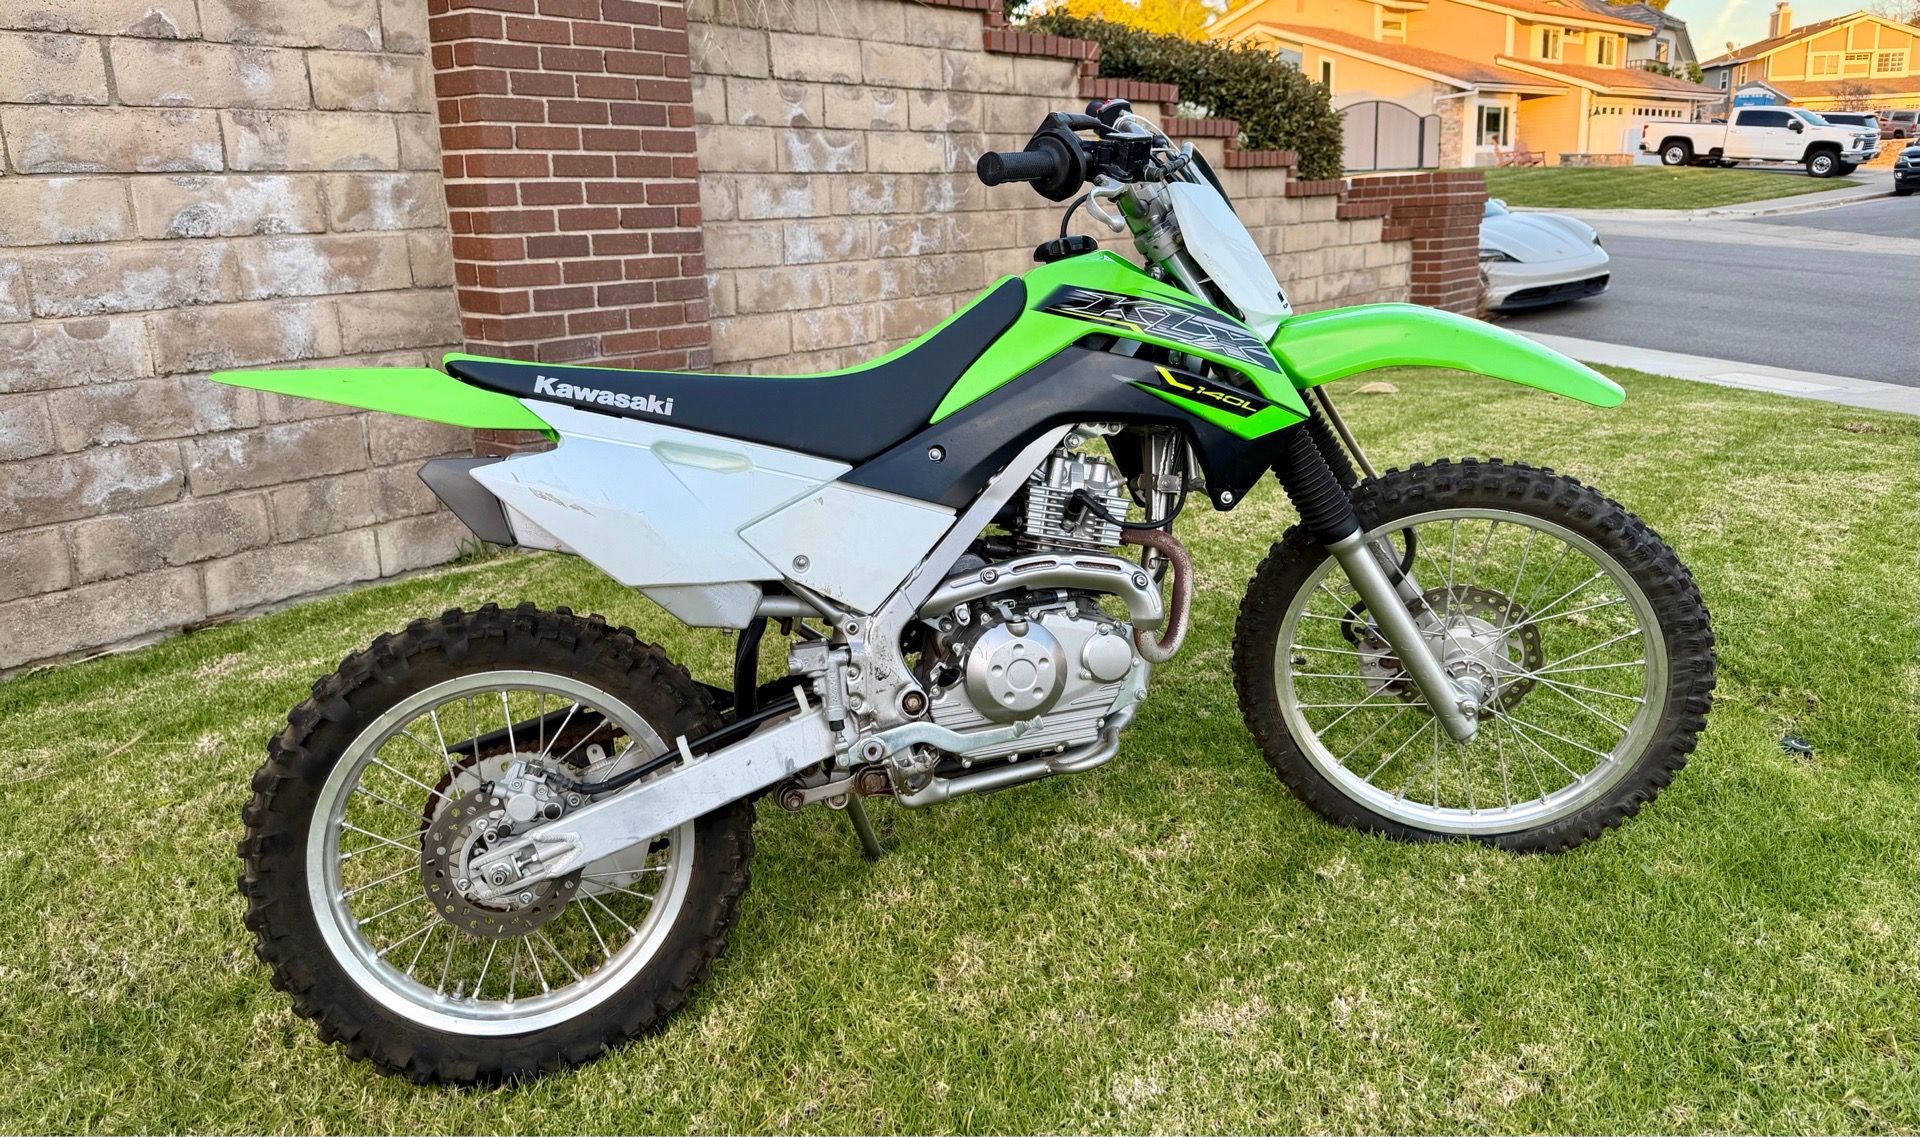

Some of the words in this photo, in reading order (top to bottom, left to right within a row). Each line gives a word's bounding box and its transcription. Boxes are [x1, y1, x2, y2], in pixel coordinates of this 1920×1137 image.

[1068, 289, 1268, 367] KLX
[533, 375, 674, 416] Kawasaki
[1196, 386, 1257, 412] 140L
